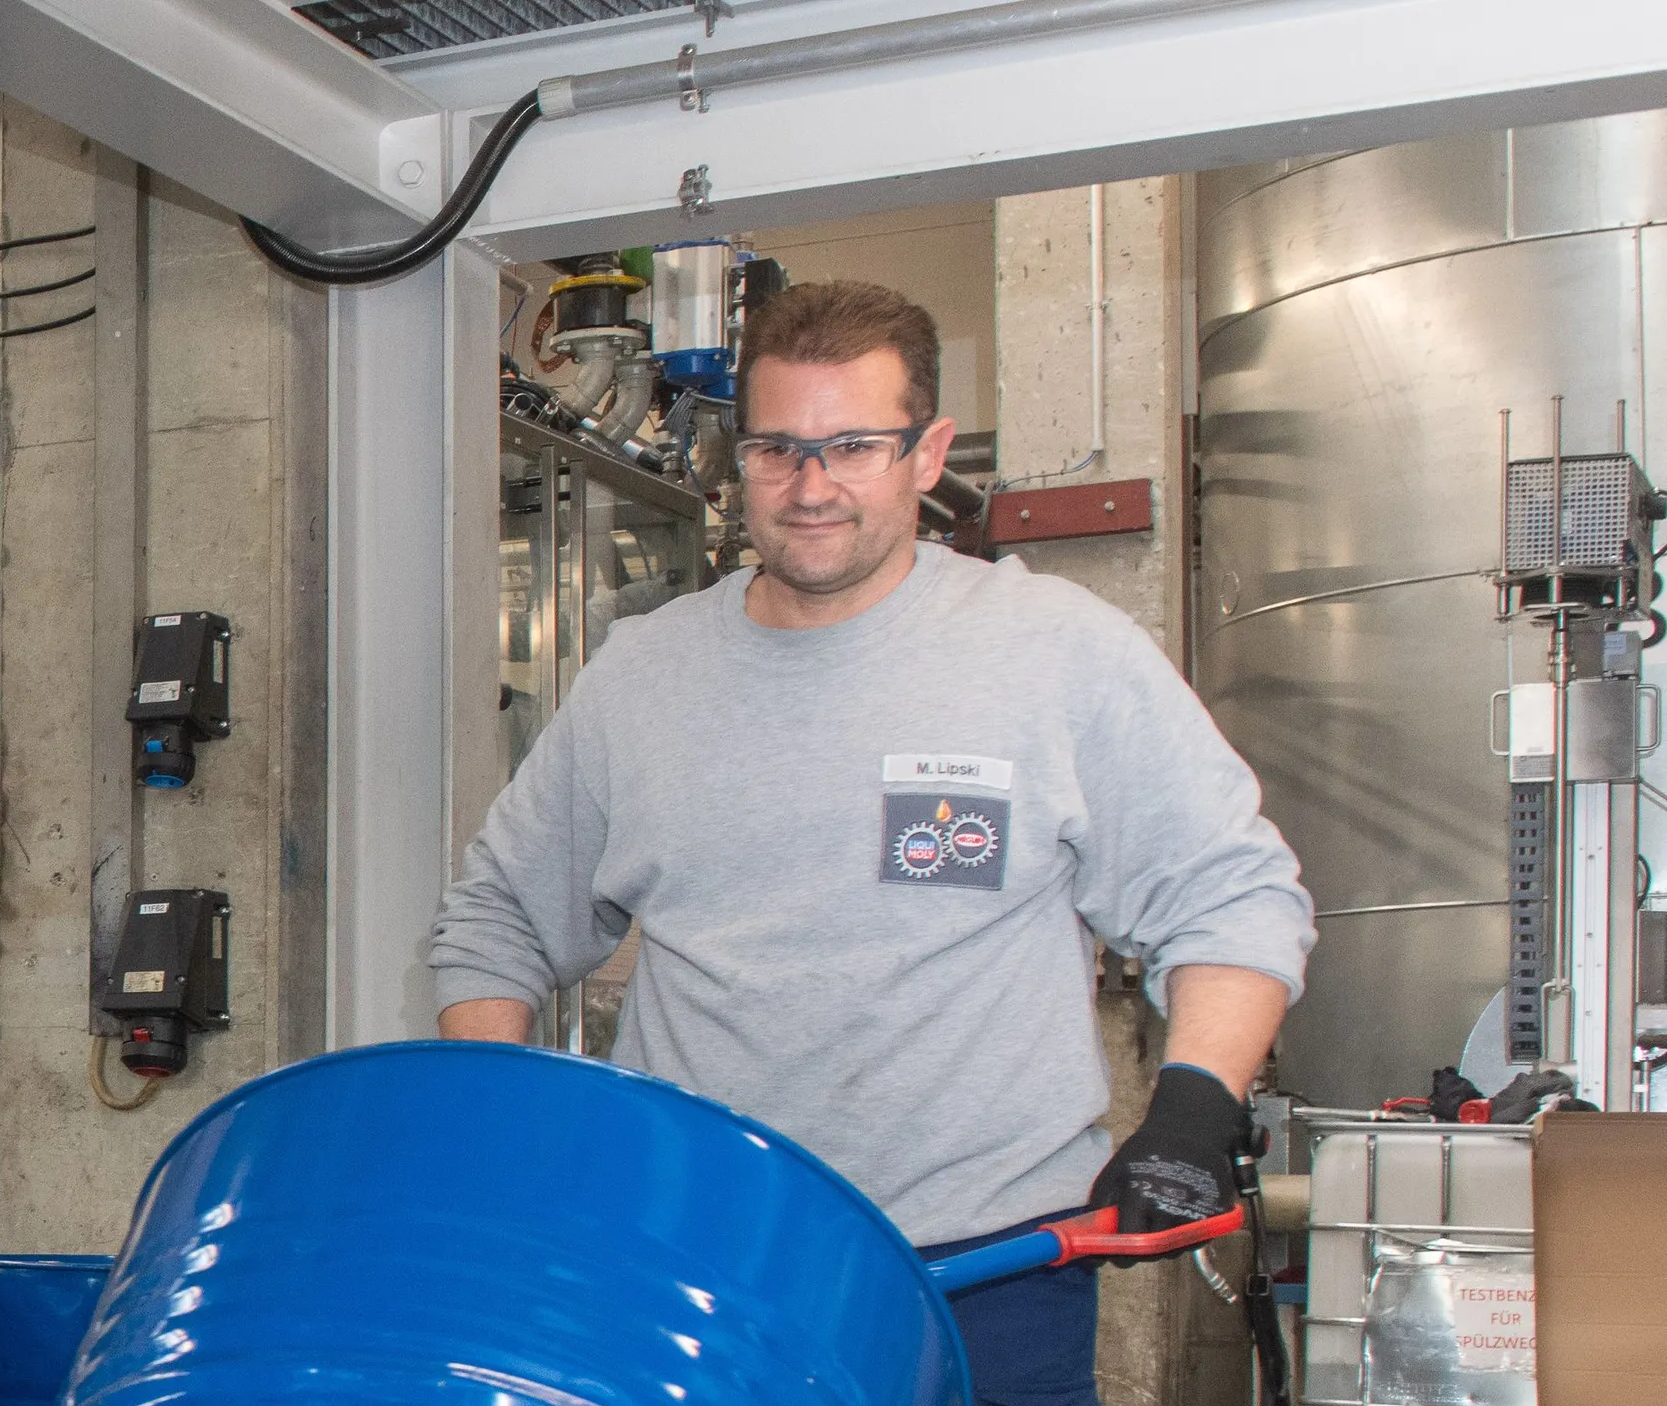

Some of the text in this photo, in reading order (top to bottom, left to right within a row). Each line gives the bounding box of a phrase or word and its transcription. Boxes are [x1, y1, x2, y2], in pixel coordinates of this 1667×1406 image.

[917, 762, 981, 776] M. Lipski
[908, 840, 935, 849] LIQUI
[907, 849, 936, 859] MOLY
[143, 904, 165, 912] 11F62
[1491, 1310, 1521, 1325] FÜR
